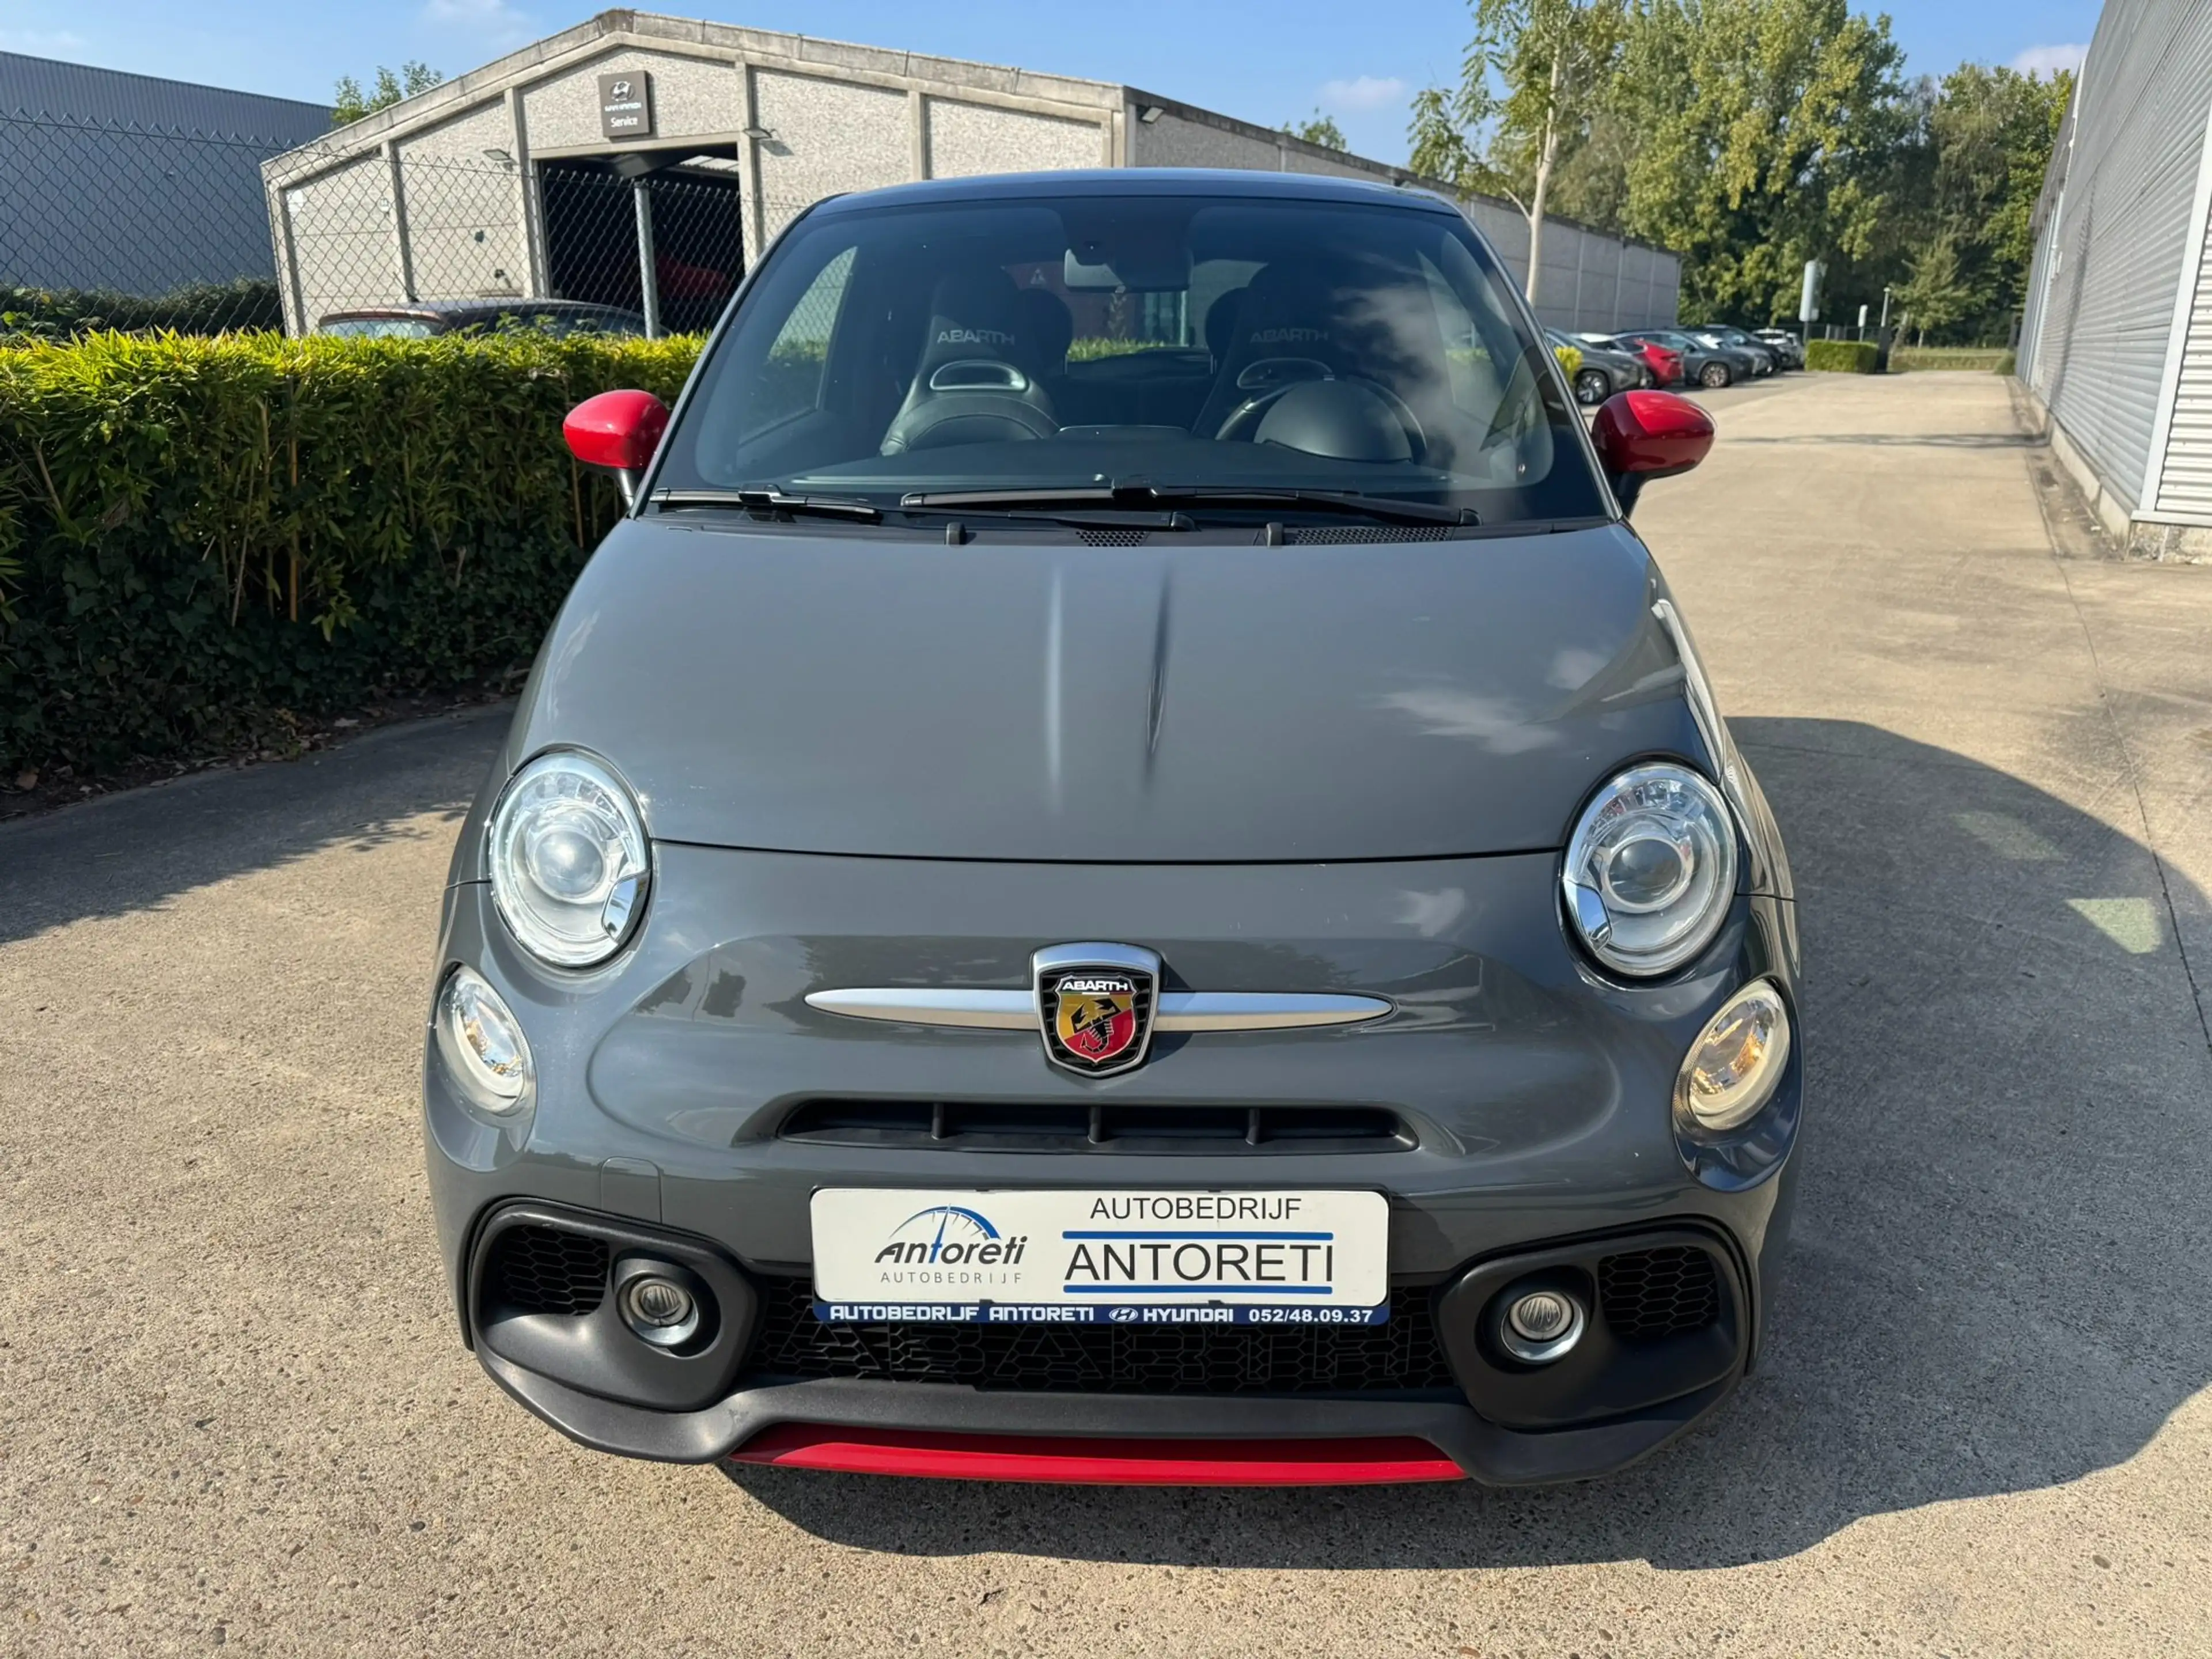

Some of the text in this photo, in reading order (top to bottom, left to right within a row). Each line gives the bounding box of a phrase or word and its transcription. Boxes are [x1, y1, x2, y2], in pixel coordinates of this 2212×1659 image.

[611, 116, 638, 127] Service
[937, 329, 1015, 346] ABARTH
[1249, 328, 1328, 344] ABARTH
[1062, 980, 1128, 991] ABARTH
[1090, 1197, 1302, 1219] AUTOBEDRIJF
[874, 1235, 1028, 1265] Antoreti
[1064, 1243, 1333, 1282] ANTORETI
[880, 1271, 1022, 1285] AUTOBEDRIJF
[830, 1305, 1373, 1323] AUTOBEDRIJF ANTORETI HYUNDAI 052/48.09.37
[774, 1305, 1412, 1381] ABARTH
